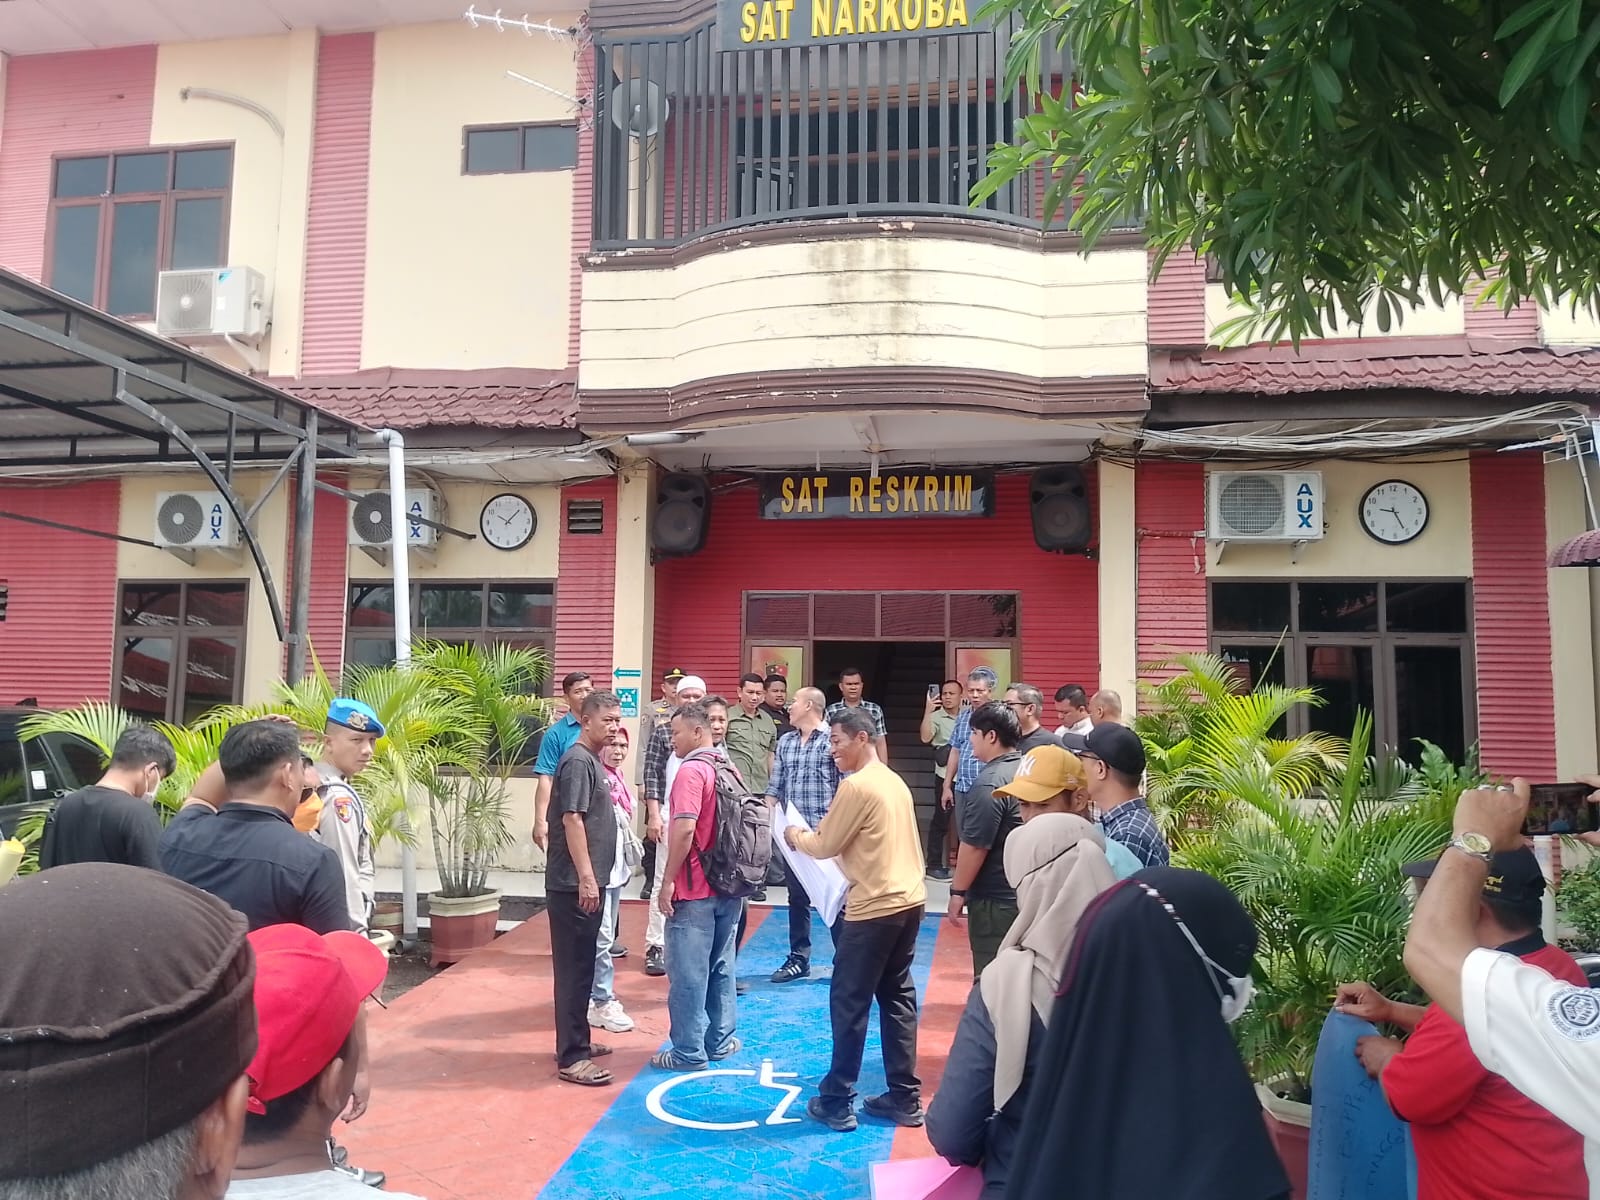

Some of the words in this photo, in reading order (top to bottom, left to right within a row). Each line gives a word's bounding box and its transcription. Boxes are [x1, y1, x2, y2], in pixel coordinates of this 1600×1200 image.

[740, 0, 795, 43] SAT
[811, 0, 968, 37] NARKOBA
[781, 476, 829, 513] SAT
[850, 475, 972, 513] RESKRIM
[1296, 483, 1313, 528] AUX
[210, 504, 222, 539] AUX
